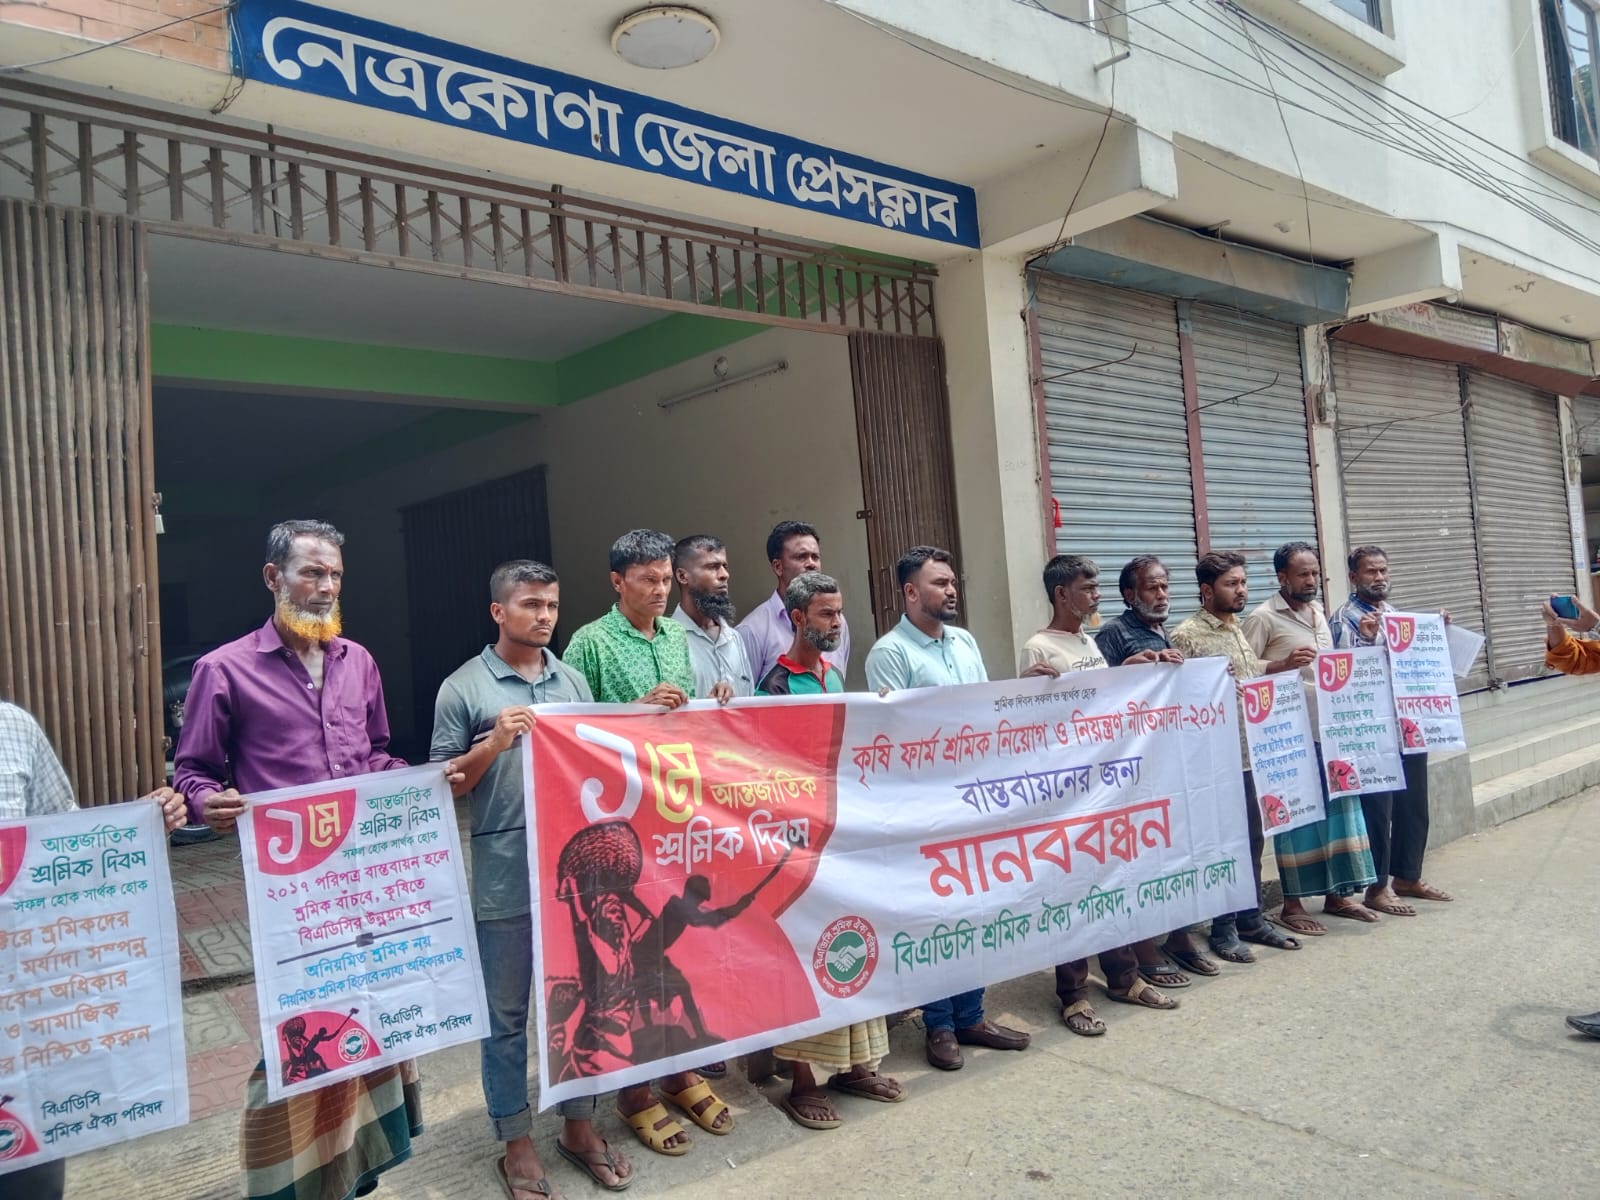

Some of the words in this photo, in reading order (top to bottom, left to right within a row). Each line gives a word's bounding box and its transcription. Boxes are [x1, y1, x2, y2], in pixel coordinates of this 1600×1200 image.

[262, 16, 624, 156] নেত্রকোণা
[634, 113, 776, 195] জেলা
[788, 152, 959, 238] প্রেসক্লাব
[1396, 696, 1453, 714] মানববন্ধন
[852, 734, 894, 791] কৃষি
[900, 726, 943, 770] ফার্ম
[943, 724, 992, 766] শ্রমিক
[996, 719, 1049, 758] নিয়োগ
[1053, 722, 1069, 745] ও
[1071, 709, 1124, 745] নিয়ন্ত্রণ
[575, 723, 643, 824] ১
[645, 742, 702, 823] মে
[711, 766, 817, 810] আন্তর্জাতিক
[955, 765, 1094, 815] বাস্তবায়নের
[1099, 756, 1143, 789] জন্য
[366, 786, 432, 811] আন্তর্জাতিক
[40, 823, 139, 854] আন্তর্জাতিক
[266, 809, 303, 864] ১
[308, 801, 340, 847] মে
[358, 812, 402, 837] শ্রমিক
[408, 806, 441, 830] দিবস
[368, 842, 388, 856] হোক
[418, 831, 438, 844] হোক
[652, 816, 744, 874] শ্রমিক
[748, 809, 810, 864] দিবস
[29, 855, 94, 887] শ্রমিক
[101, 848, 147, 879] দিবস
[920, 799, 1172, 898] মানববন্ধন
[12, 896, 46, 913] সফল
[51, 890, 81, 908] হোক
[84, 882, 116, 900] সার্থক
[121, 879, 149, 895] হোক
[267, 880, 309, 902] ২০১৭
[315, 869, 360, 892] পরিপত্র
[364, 856, 420, 879] বাস্তবায়ন
[423, 849, 450, 867] হলে
[293, 899, 331, 923] শ্রমিক
[382, 877, 426, 901] কৃষিতে
[891, 918, 977, 975] বিএডিসি
[981, 909, 1032, 953] শ্রমিক
[1037, 897, 1073, 936] ঐক্য
[1078, 885, 1131, 923] পরিষদ,
[1136, 868, 1199, 909] নেত্রকোনা
[1203, 858, 1237, 891] জেলা
[39, 910, 130, 946] শ্রমিকদের
[297, 916, 362, 946] বিএডিসির
[365, 906, 404, 927] উন্নয়ন
[407, 900, 432, 916] হবে
[21, 944, 80, 976] মর্যাদা
[86, 936, 147, 960] সম্পন্ন
[305, 950, 367, 979] অনিয়মিত
[370, 940, 409, 963] শ্রমিক
[411, 934, 432, 951] নয়
[49, 970, 129, 999] অধিকার
[277, 988, 316, 1010] নিয়মিত
[317, 978, 346, 999] শ্রমিক
[347, 972, 380, 990] হিসেবে
[405, 955, 445, 972] অধিকার
[446, 947, 466, 963] চাই
[28, 1002, 120, 1037] সামাজিক
[379, 1004, 423, 1029] বিএডিসি
[382, 1029, 412, 1050] শ্রমিক
[414, 1022, 437, 1037] ঐক্য
[439, 1014, 472, 1032] পরিষদ
[22, 1038, 92, 1070] নিশ্চিত
[97, 1025, 151, 1050] করুন
[40, 1090, 101, 1120] বিএডিসি
[43, 1119, 83, 1145] শ্রমিক
[87, 1112, 118, 1130] ঐক্য
[122, 1100, 163, 1122] পরিষদ
